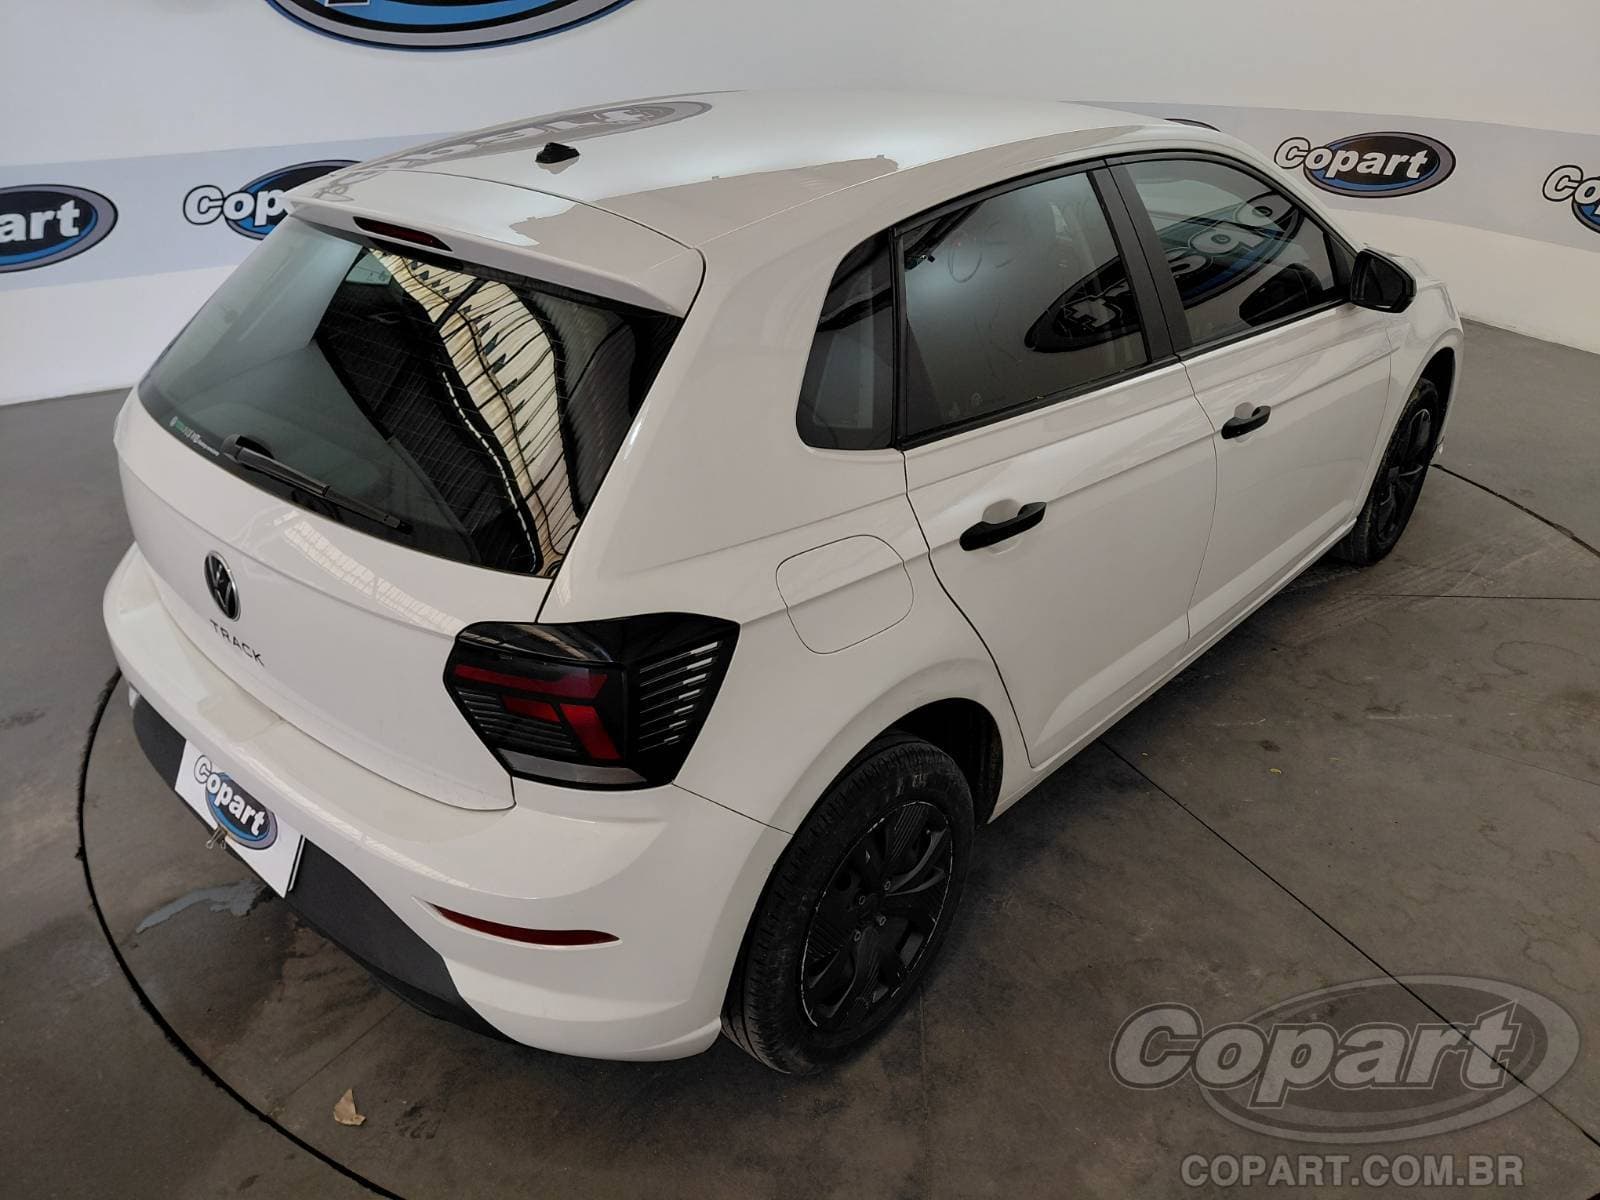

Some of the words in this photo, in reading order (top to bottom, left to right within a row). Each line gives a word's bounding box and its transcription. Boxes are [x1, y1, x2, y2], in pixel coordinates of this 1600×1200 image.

[1274, 137, 1429, 180] Copart
[183, 185, 288, 227] Cop
[1543, 165, 1600, 215] Co
[0, 199, 81, 243] art
[210, 619, 264, 667] TRACK
[194, 755, 266, 836] Copart
